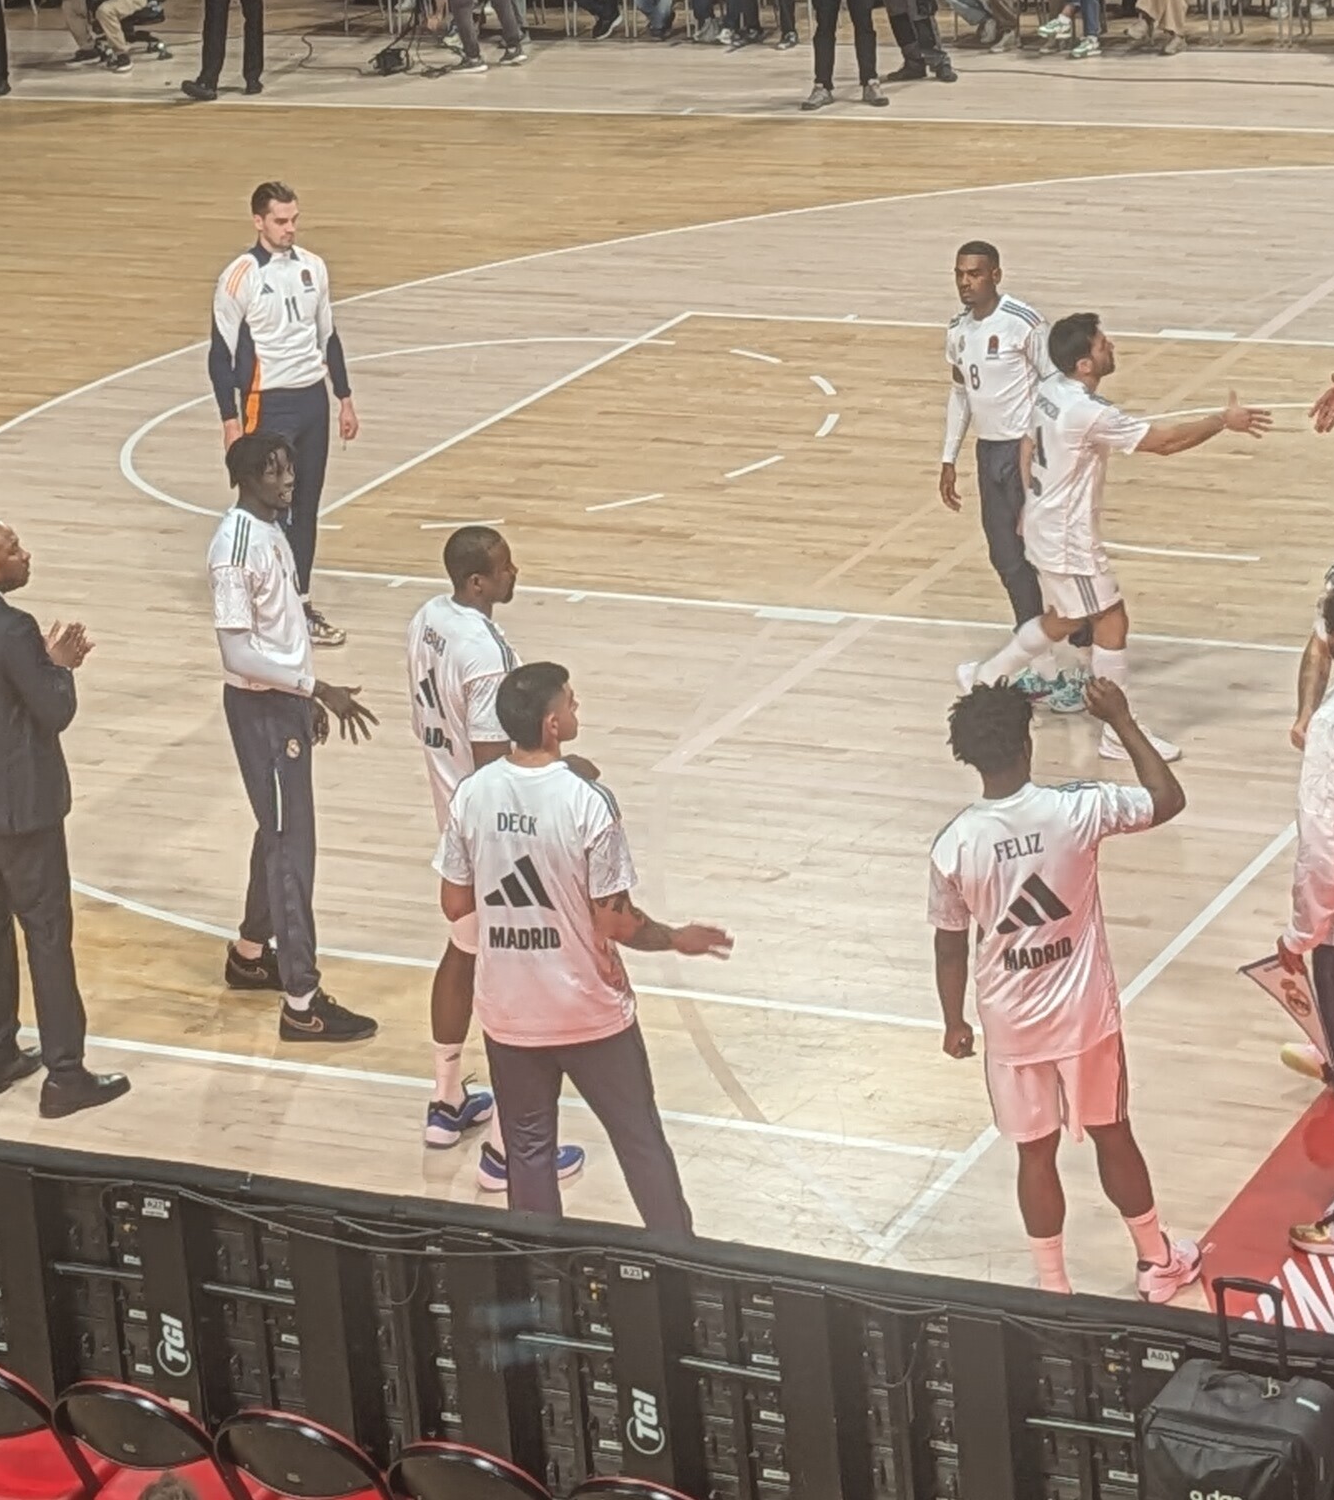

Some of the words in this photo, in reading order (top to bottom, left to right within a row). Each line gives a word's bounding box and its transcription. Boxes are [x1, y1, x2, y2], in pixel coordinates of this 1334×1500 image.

[969, 364, 981, 390] 8
[497, 812, 538, 837] DECK
[993, 832, 1045, 863] FELIZ
[488, 926, 562, 950] MADRID
[1003, 936, 1074, 972] MADRID
[161, 1312, 186, 1363] TGI
[631, 1387, 660, 1441] TGI
